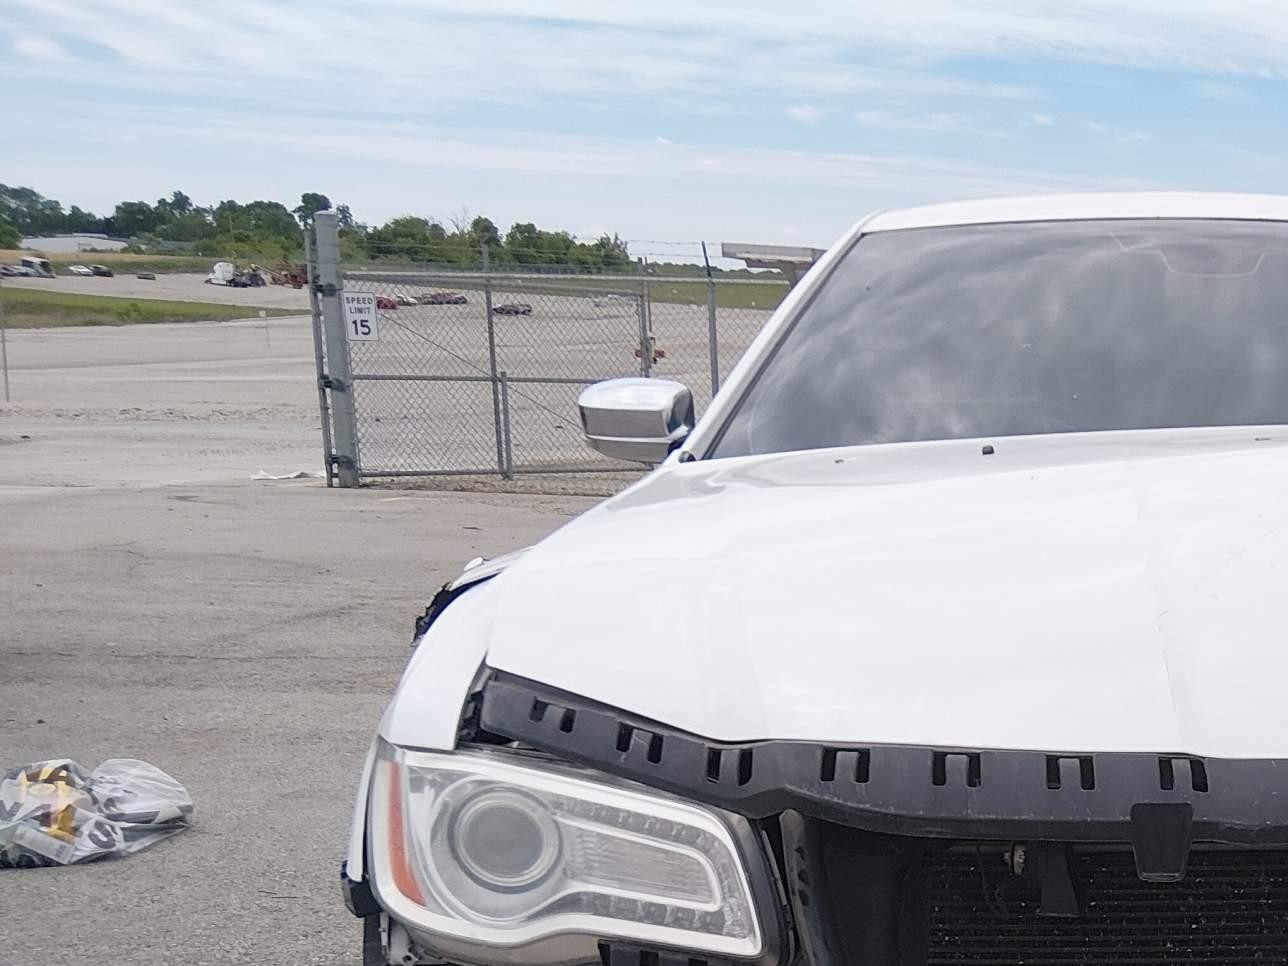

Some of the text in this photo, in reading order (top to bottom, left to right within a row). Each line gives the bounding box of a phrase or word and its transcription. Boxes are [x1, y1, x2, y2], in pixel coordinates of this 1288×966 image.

[345, 296, 373, 305] SPEED
[350, 306, 371, 314] LIMIT
[351, 319, 372, 336] 15
